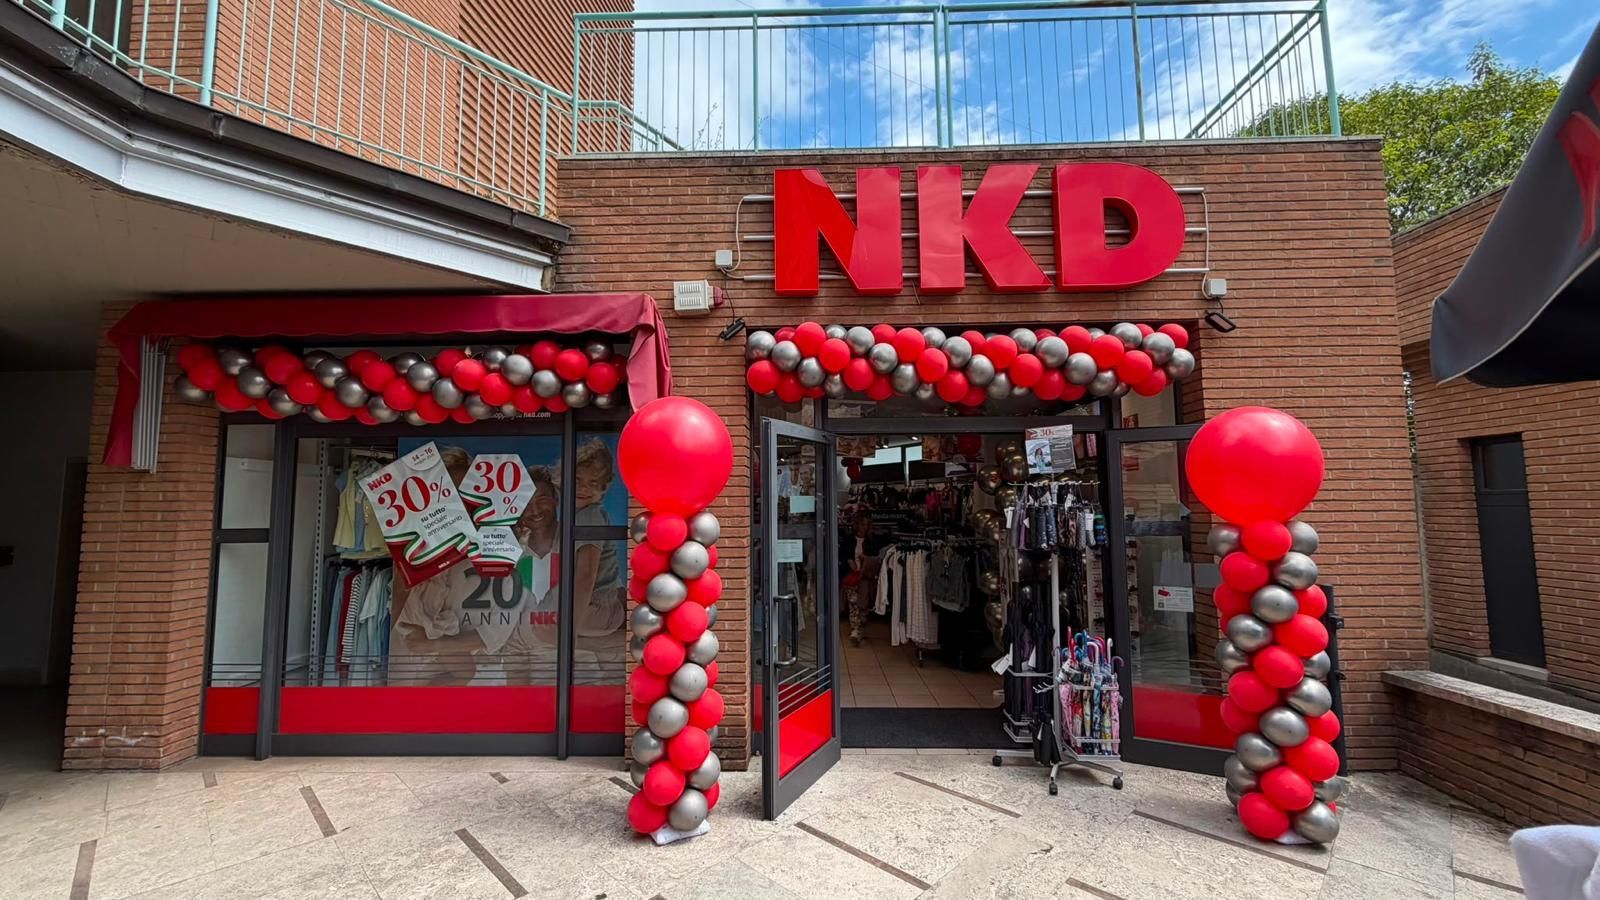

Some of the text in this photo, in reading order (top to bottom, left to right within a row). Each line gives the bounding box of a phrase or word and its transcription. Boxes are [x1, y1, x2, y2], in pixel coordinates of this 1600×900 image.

[774, 162, 1186, 296] NKD
[367, 472, 393, 491] NKD
[473, 460, 522, 494] 30
[377, 475, 451, 528] 30%
[503, 495, 518, 514] %
[420, 514, 430, 523] su
[423, 514, 448, 530] speciale
[427, 515, 463, 537] anniversario
[462, 567, 523, 609] 20
[462, 611, 522, 625] ANNI
[530, 611, 560, 625] NK
